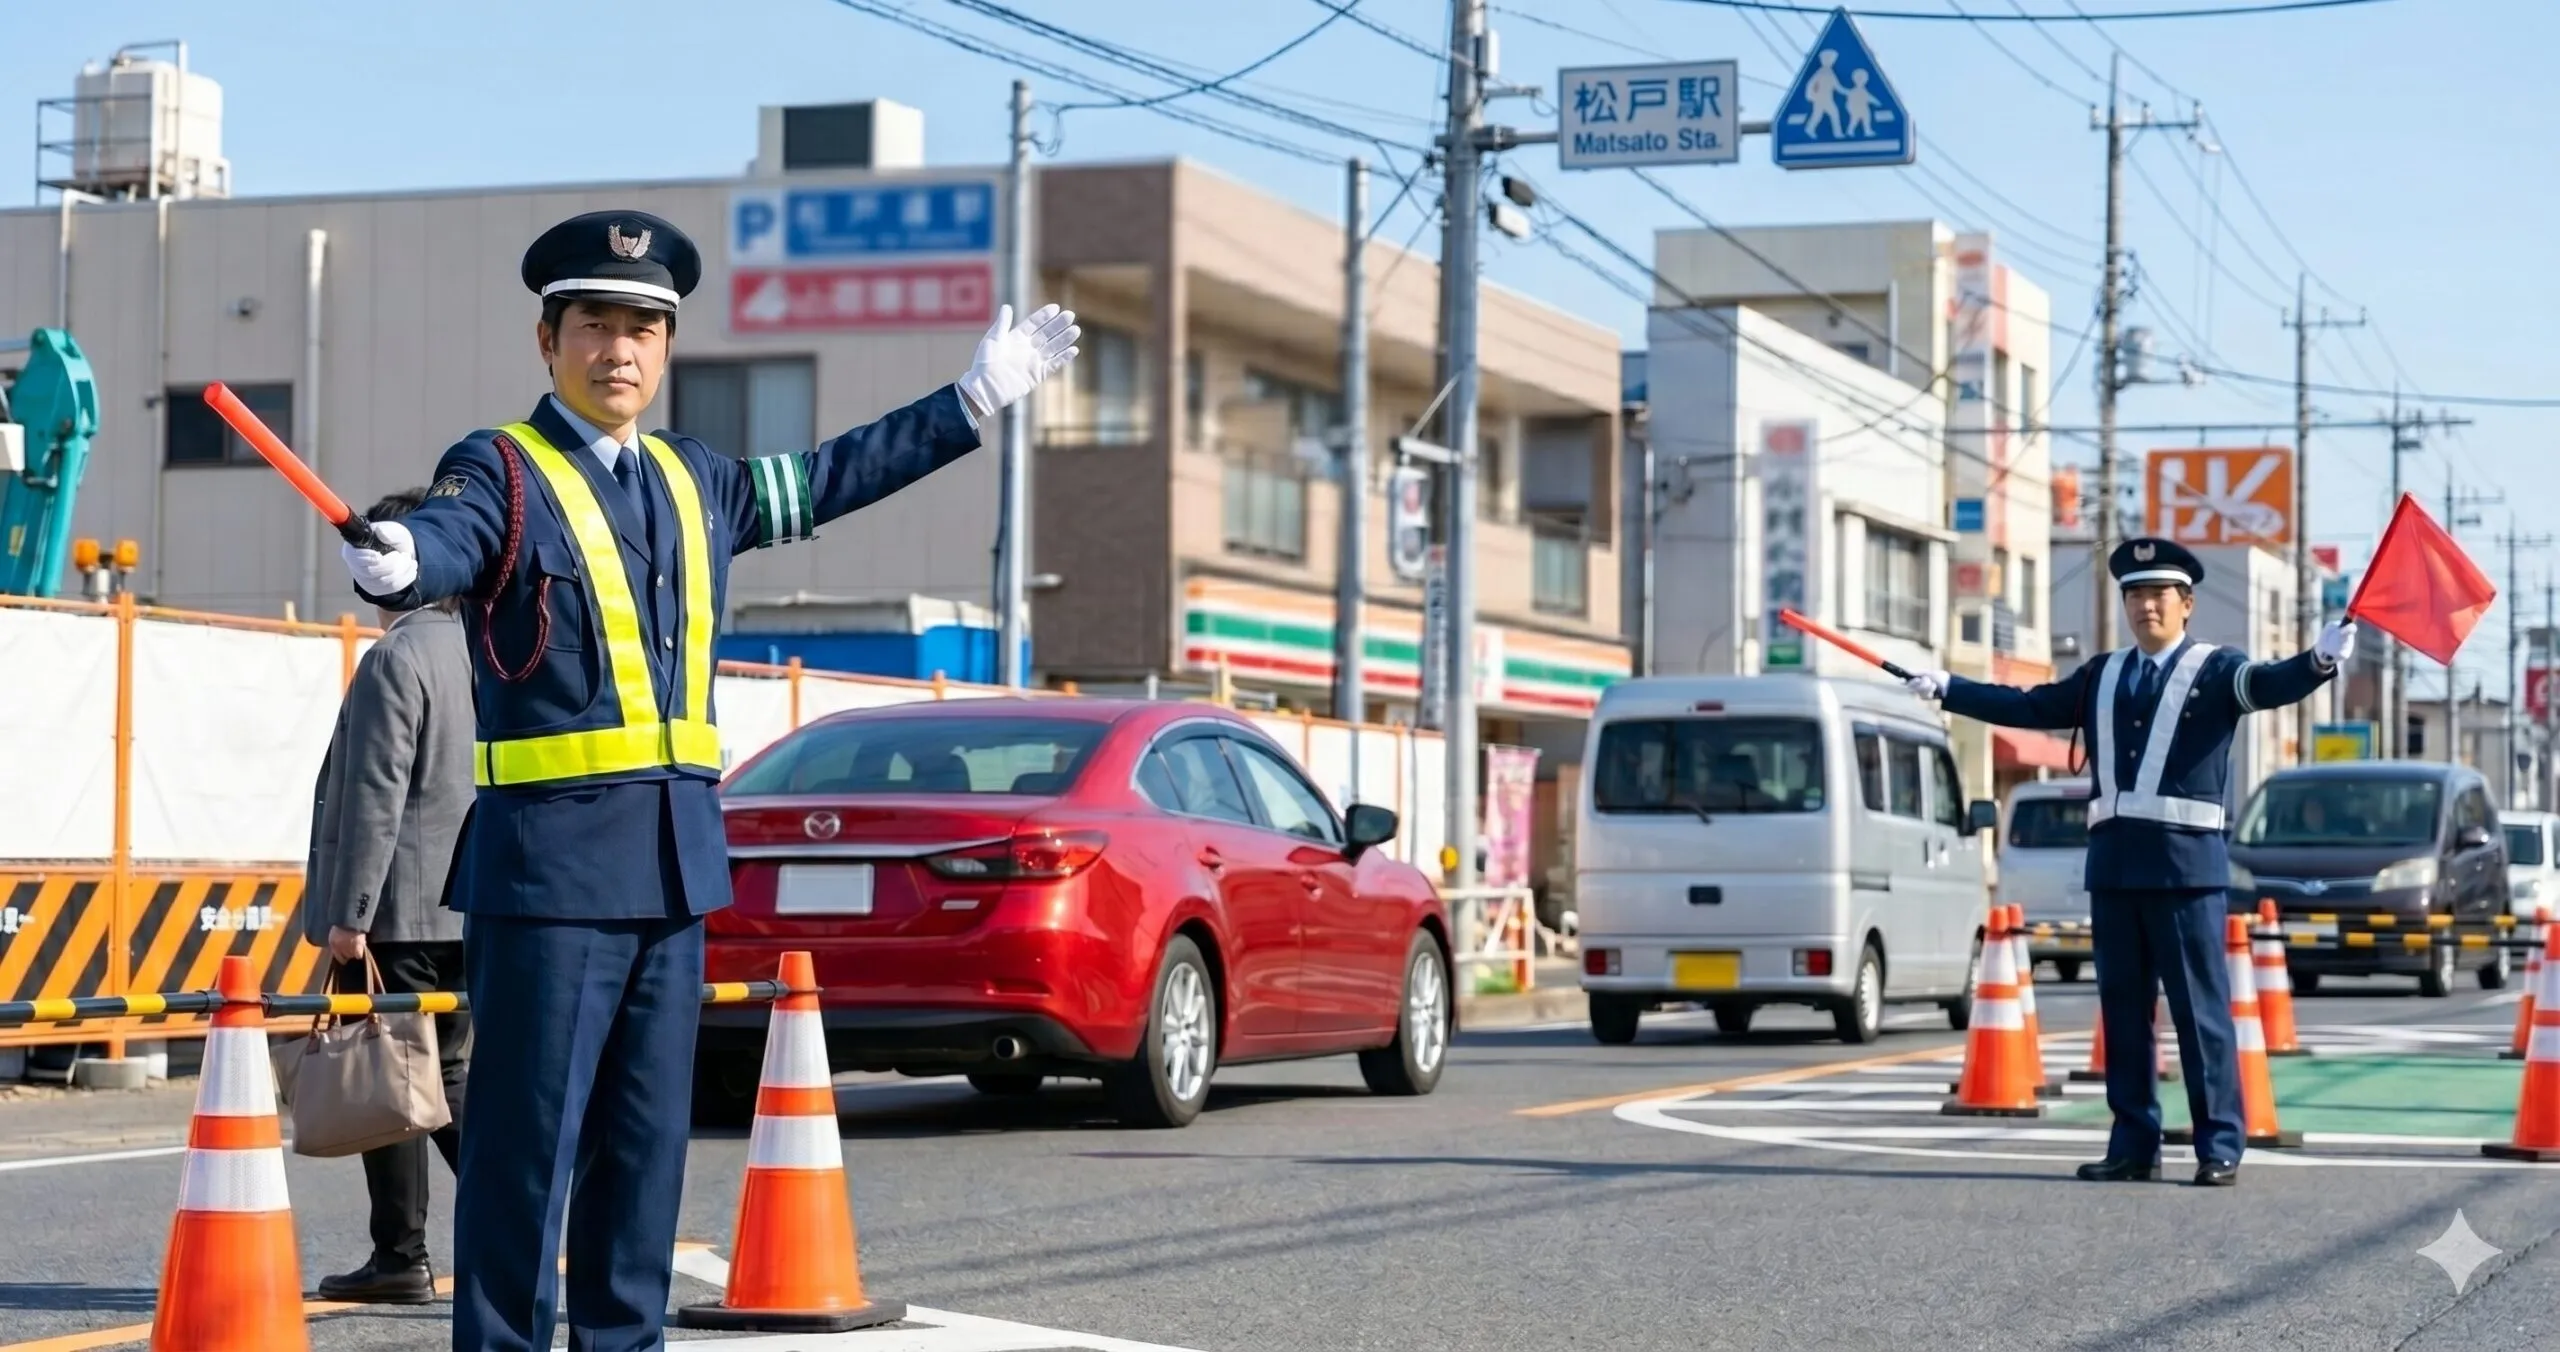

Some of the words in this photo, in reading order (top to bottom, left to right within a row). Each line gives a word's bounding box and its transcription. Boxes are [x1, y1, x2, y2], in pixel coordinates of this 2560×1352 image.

[1574, 76, 1722, 125] 松戸駅
[1574, 131, 1668, 155] Matsato
[1677, 127, 1722, 151] Sta.
[736, 199, 776, 251] P
